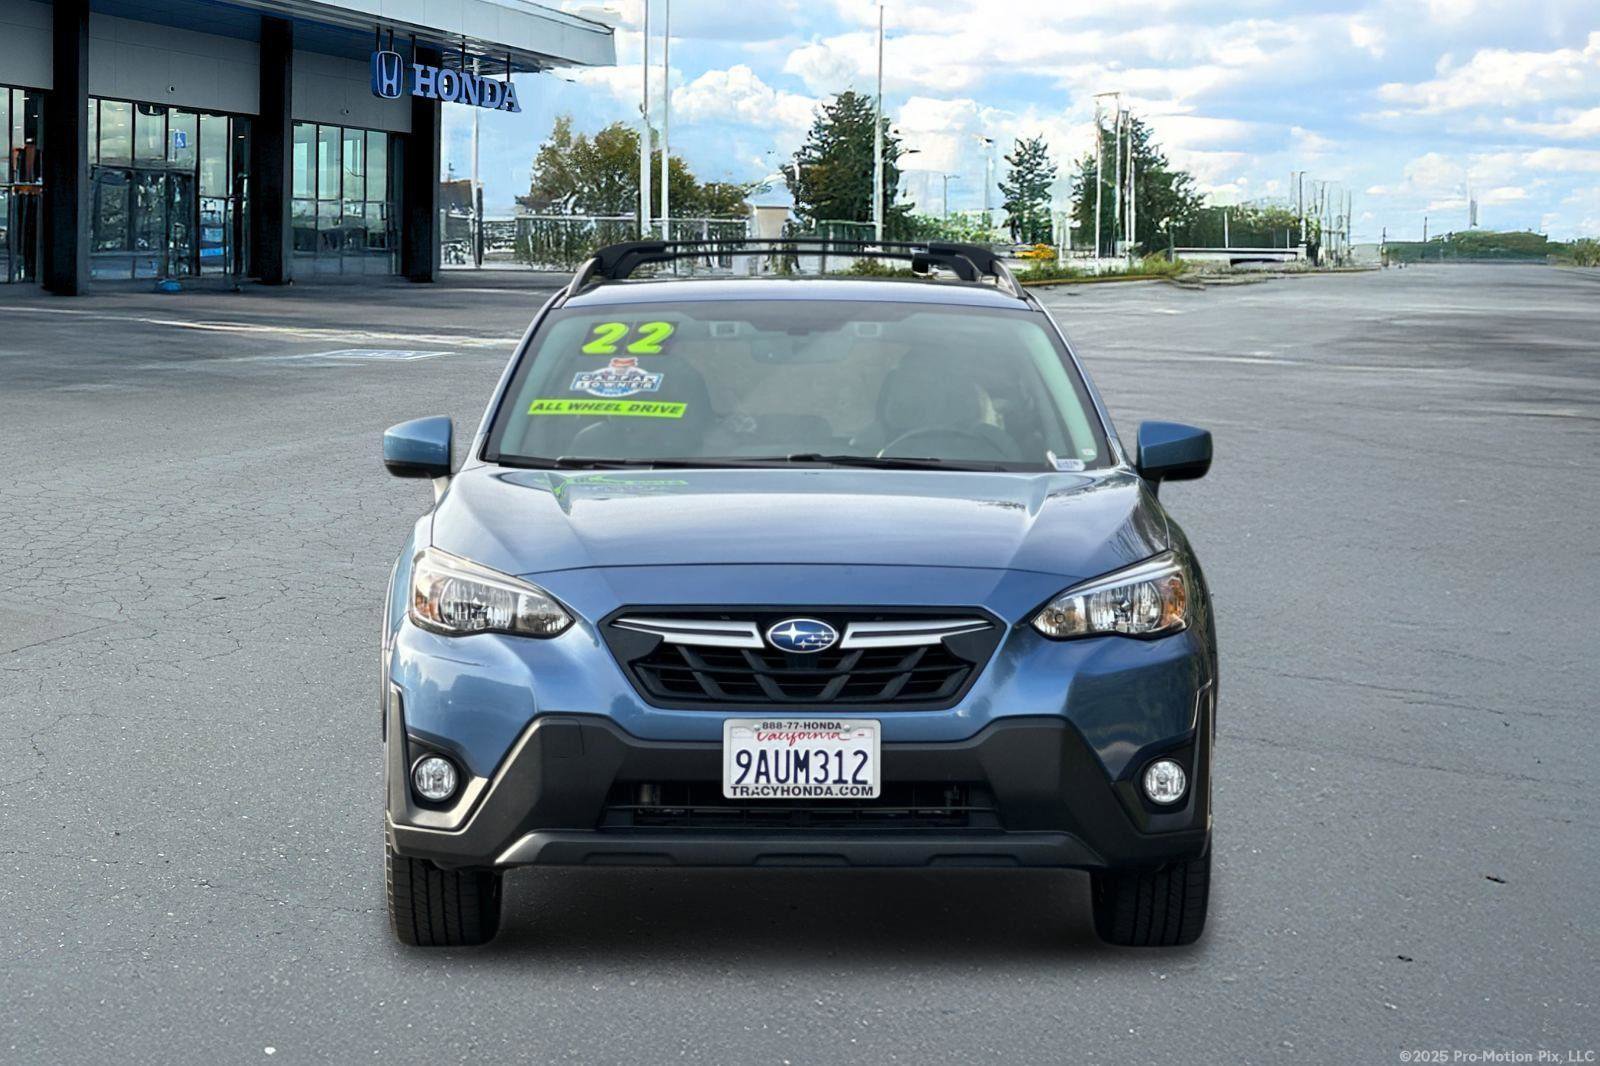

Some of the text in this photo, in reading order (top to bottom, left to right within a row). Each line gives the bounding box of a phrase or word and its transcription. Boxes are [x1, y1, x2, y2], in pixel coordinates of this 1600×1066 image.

[411, 63, 521, 113] HONDA
[582, 322, 674, 354] 22
[533, 402, 681, 414] ALL WHEEL DRIVE
[762, 721, 842, 730] 888-77-HONDA
[735, 749, 868, 785] 9AUM312
[731, 786, 873, 796] TRACYHONDA.COM
